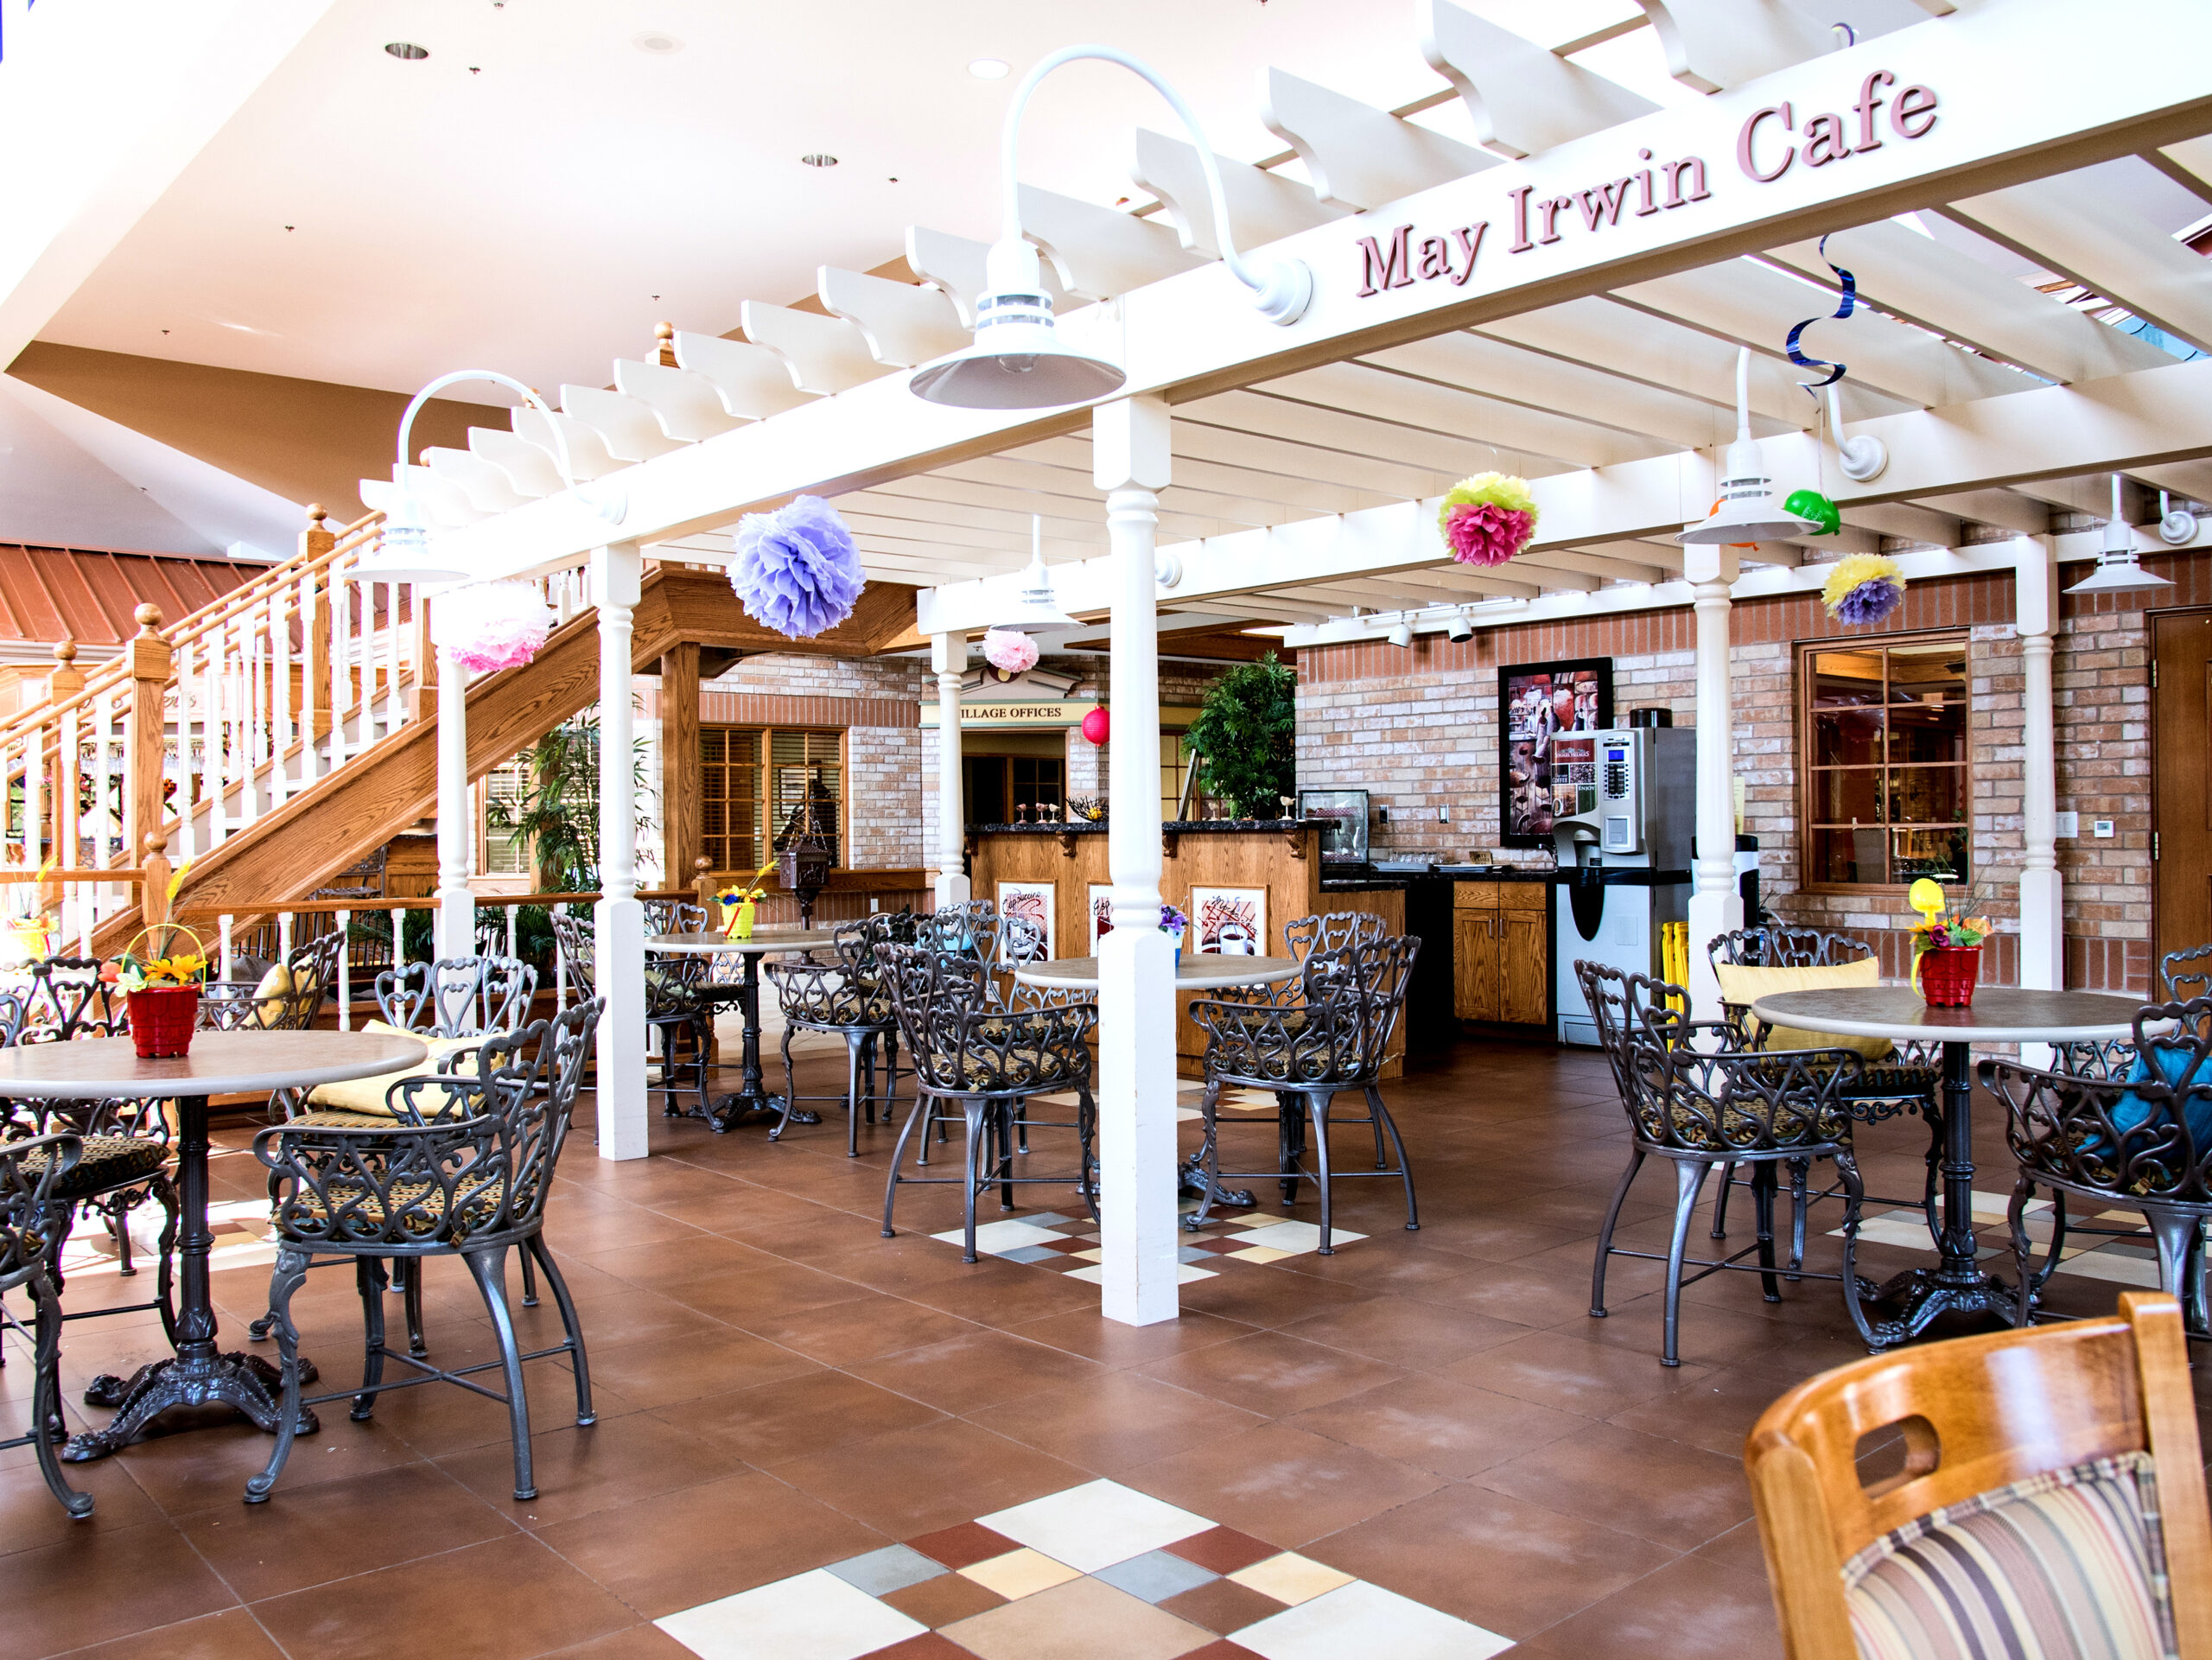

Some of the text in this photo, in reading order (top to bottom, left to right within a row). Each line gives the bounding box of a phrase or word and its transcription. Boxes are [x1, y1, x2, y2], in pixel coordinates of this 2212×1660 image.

[1355, 68, 1940, 299] May Irwin Cafe
[961, 707, 1062, 718] ILLAGE OFFICES
[1002, 891, 1041, 915] Cappuccino
[1093, 899, 1114, 916] Esp
